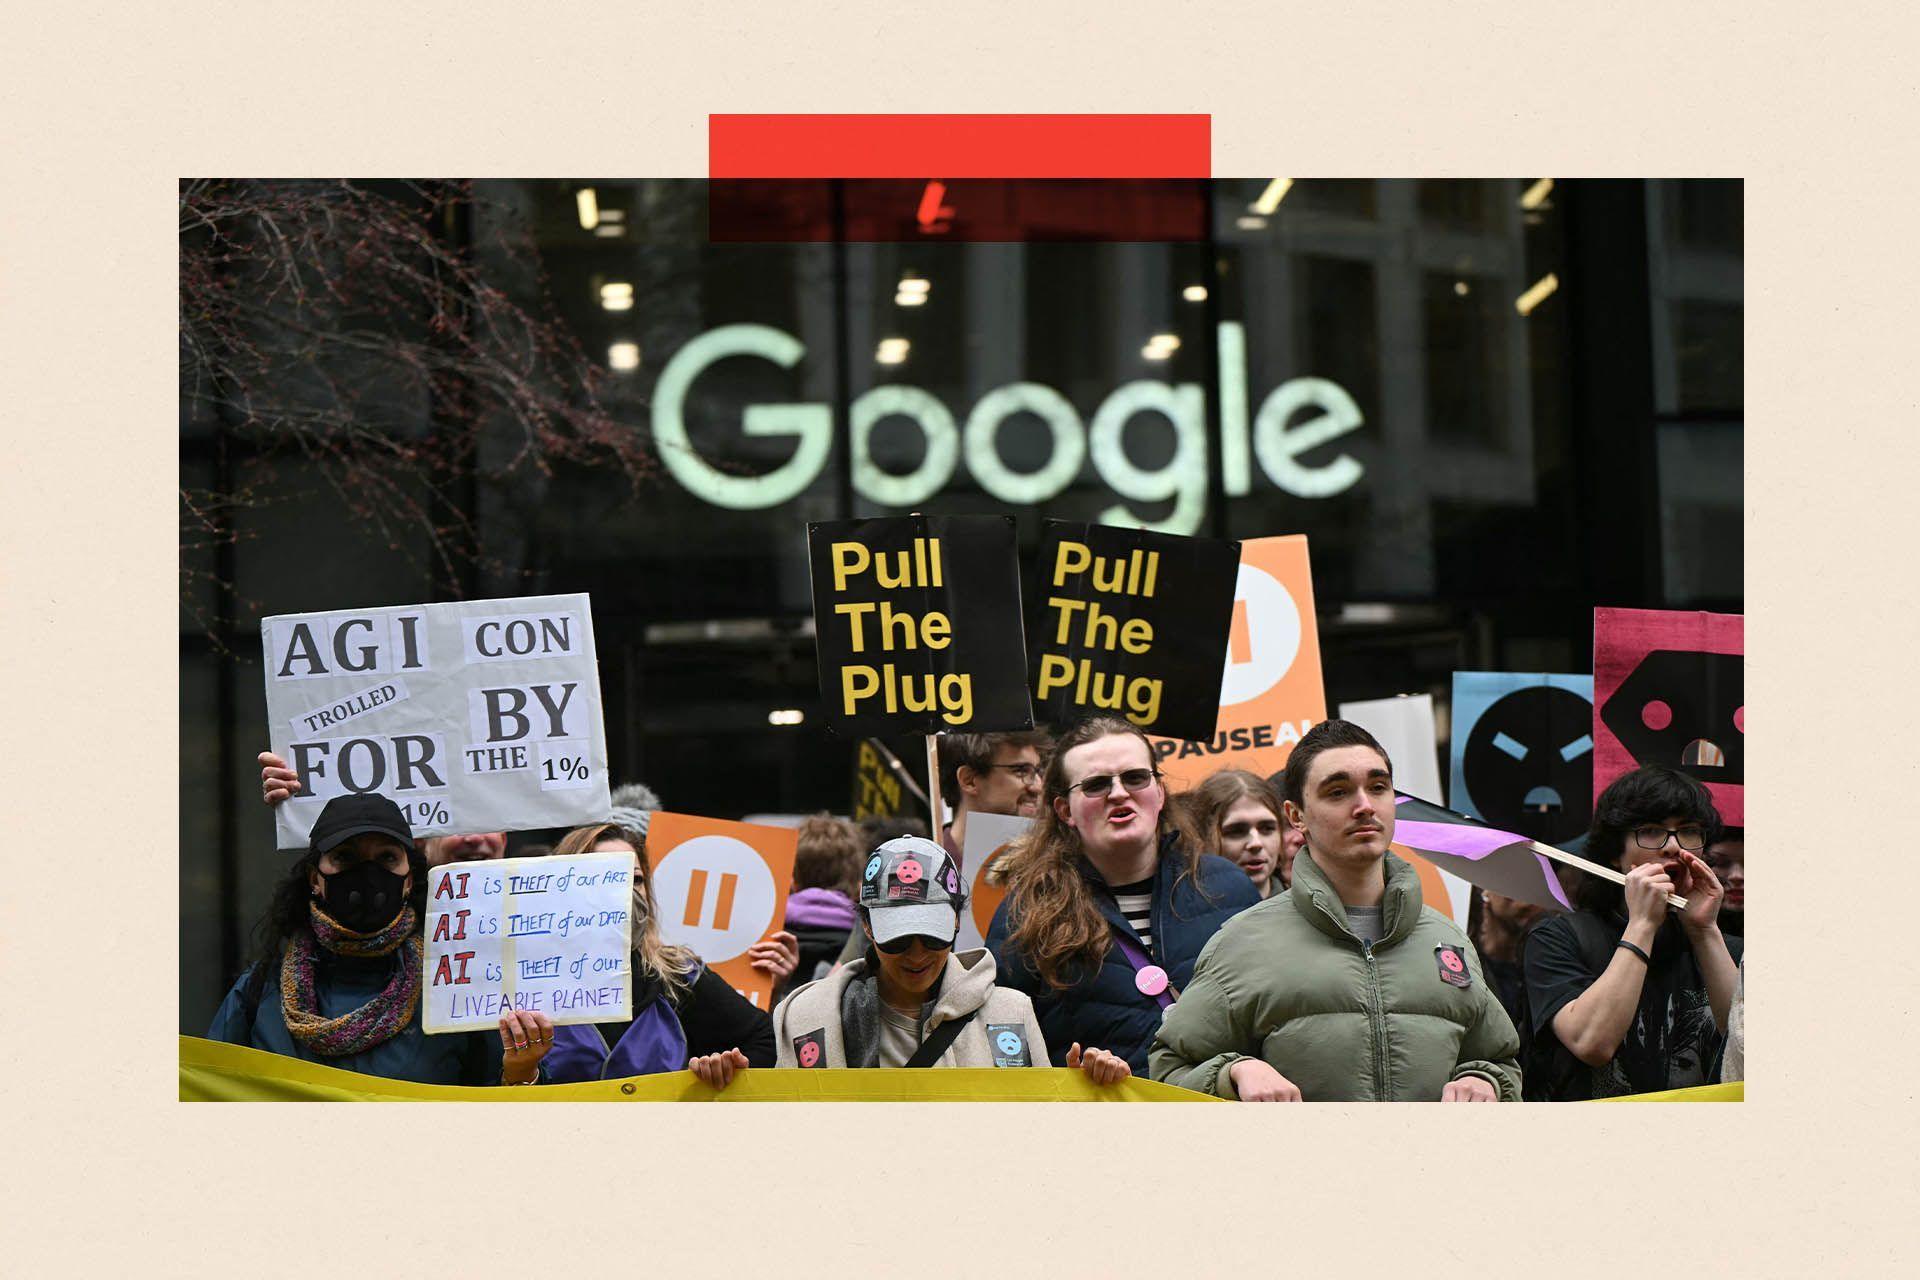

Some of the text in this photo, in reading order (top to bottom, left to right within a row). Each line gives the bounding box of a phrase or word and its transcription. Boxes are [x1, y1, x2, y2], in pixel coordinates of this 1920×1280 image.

[651, 320, 1364, 537] Google
[831, 538, 943, 591] Pull
[1052, 541, 1160, 598] Pull
[277, 616, 570, 677] AGI CON
[834, 601, 952, 652] The
[1048, 596, 1154, 654] The
[304, 685, 397, 733] TROLLED
[481, 683, 577, 743] BY
[840, 663, 974, 725] Plug
[1037, 654, 1163, 726] Plug
[290, 735, 446, 798] FOR
[466, 746, 589, 781] THE 1%
[402, 801, 449, 826] 1%
[435, 872, 470, 900] AI
[484, 878, 502, 895] is
[509, 875, 554, 894] THEFT
[556, 867, 575, 892] of
[576, 873, 600, 886] our
[433, 909, 471, 942] AI
[478, 915, 497, 935] is
[508, 912, 556, 936] THEFT
[558, 911, 574, 937] of
[575, 914, 595, 926] our
[433, 951, 623, 986] AI is THEFT of our
[451, 987, 624, 1019] LIVEABLE PLANET.
